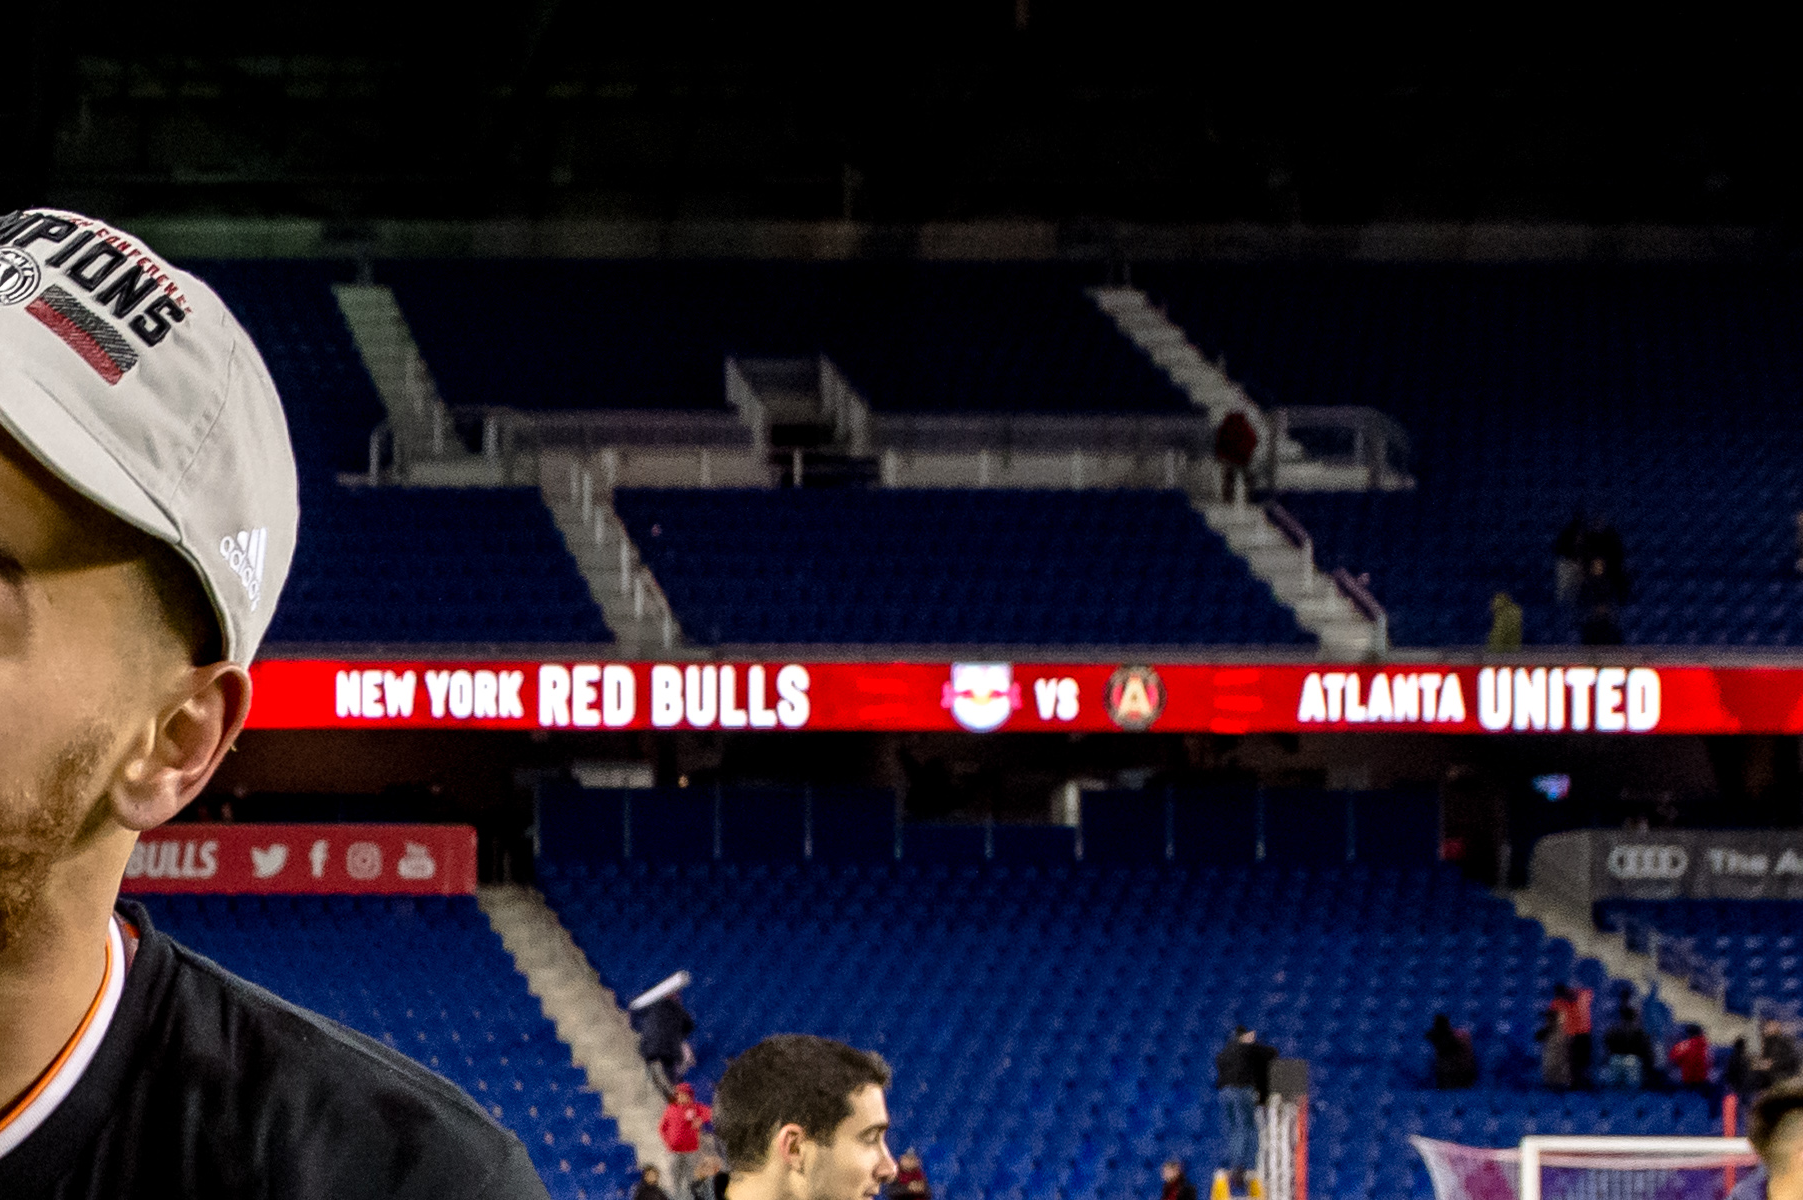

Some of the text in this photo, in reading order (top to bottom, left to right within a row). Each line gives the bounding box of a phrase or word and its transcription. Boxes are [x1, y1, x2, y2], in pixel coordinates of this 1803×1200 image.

[335, 664, 810, 728] NEW YORK RED BULLS
[1298, 667, 1661, 732] ATLANTA UNITED
